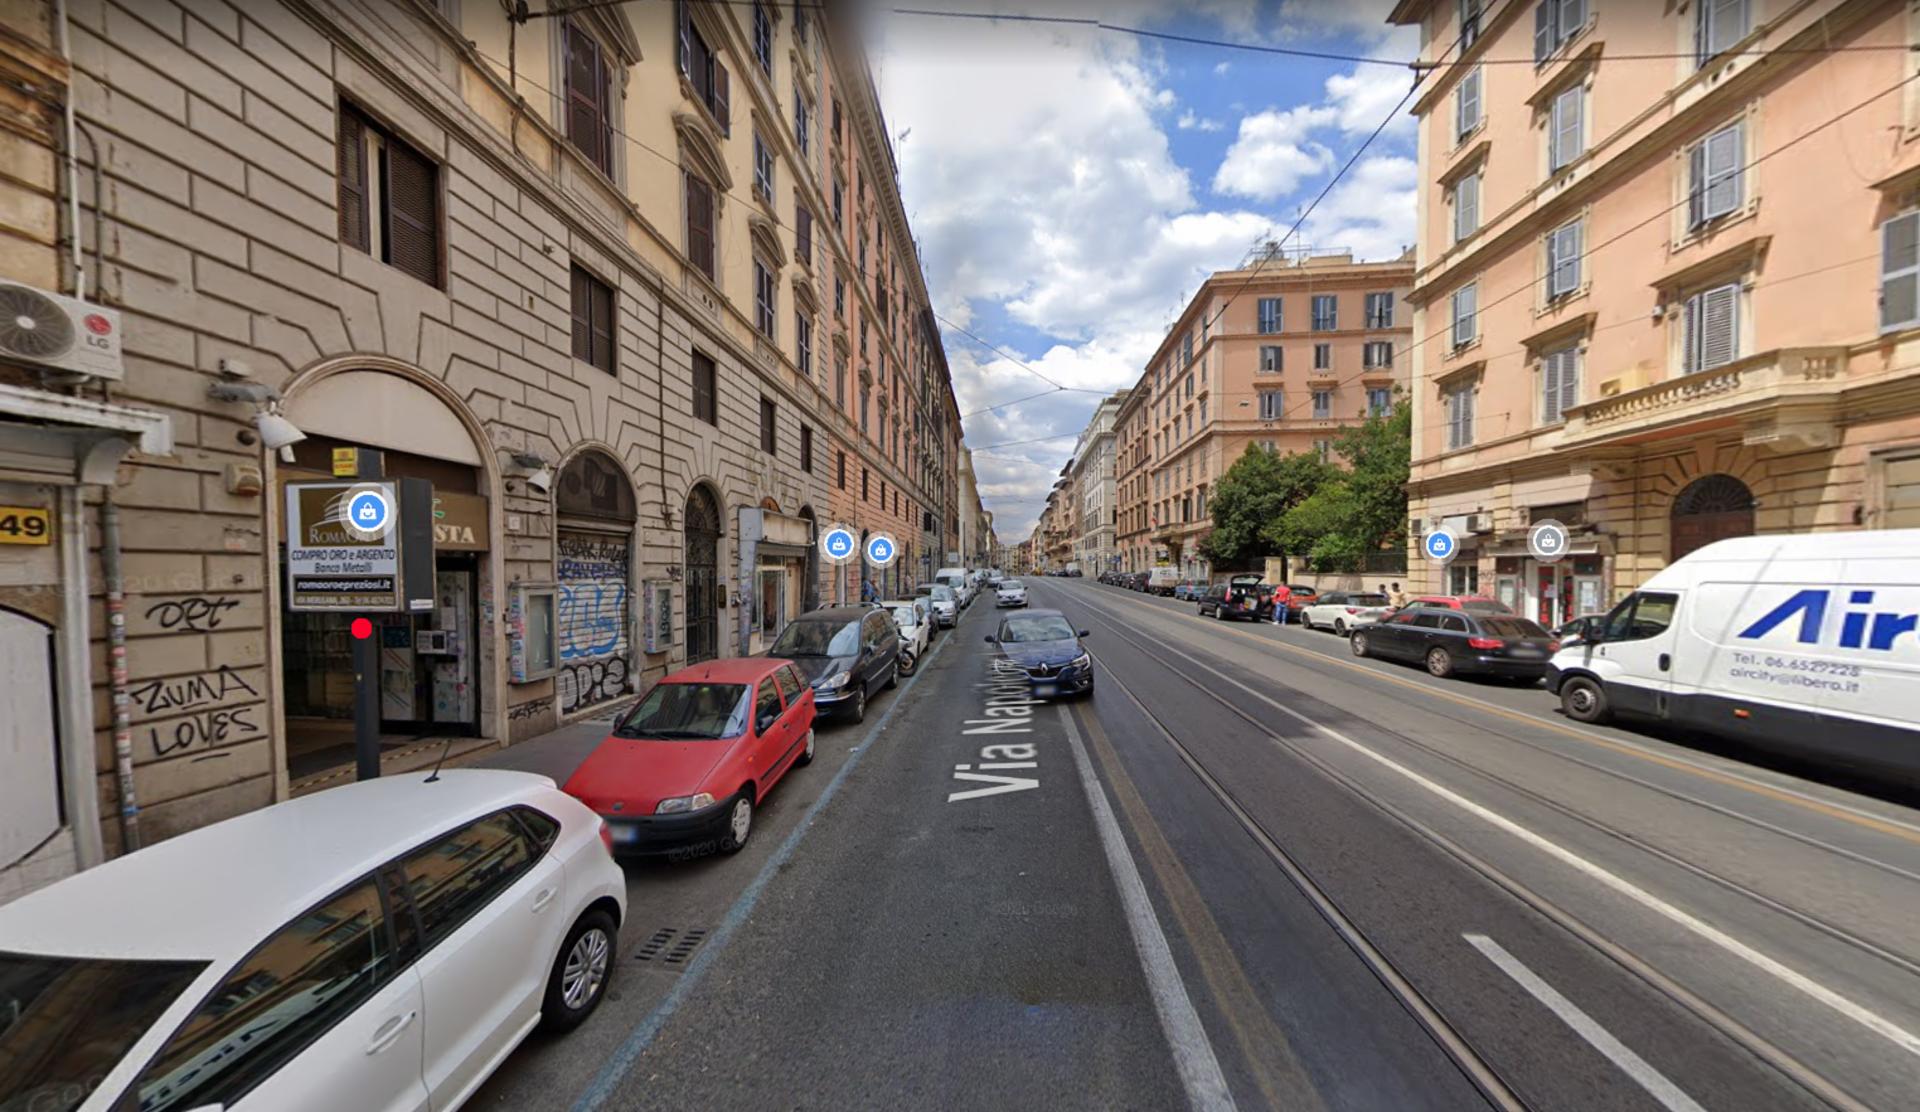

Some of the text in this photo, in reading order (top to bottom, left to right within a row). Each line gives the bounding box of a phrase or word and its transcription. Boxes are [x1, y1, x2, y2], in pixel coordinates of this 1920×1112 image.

[86, 335, 109, 350] LG
[0, 514, 45, 537] 49
[434, 523, 476, 545] STA
[292, 549, 328, 561] COMPRO
[329, 549, 348, 560] ORO
[355, 549, 395, 560] ARGENTO
[314, 562, 373, 573] Banca Metalli
[1733, 652, 1761, 666] Tel.
[130, 664, 258, 713] ZUMA
[151, 708, 258, 756] LOVES
